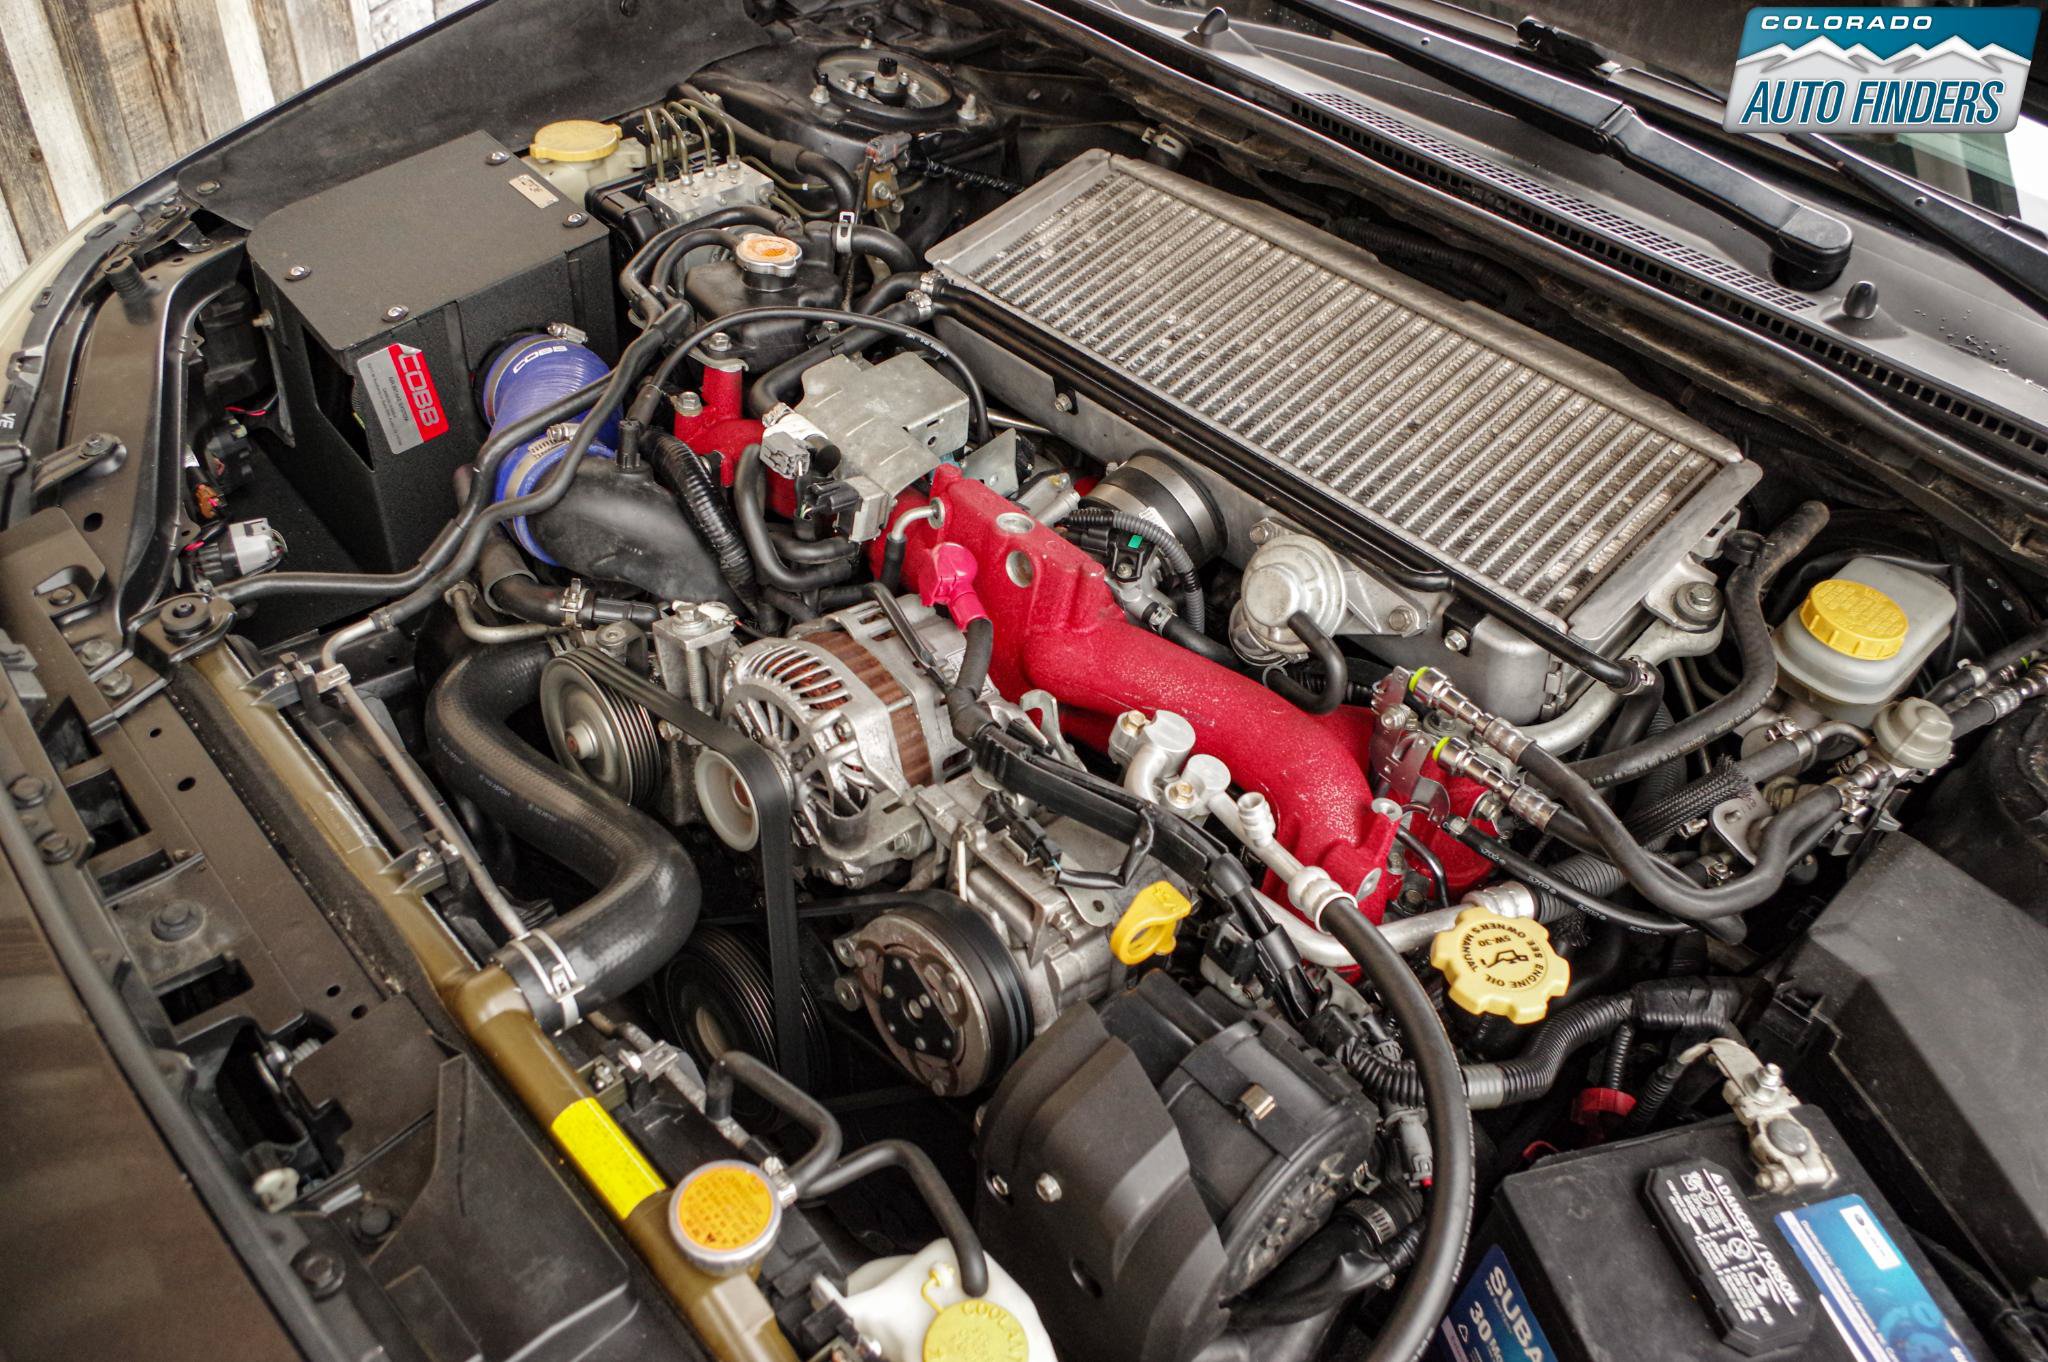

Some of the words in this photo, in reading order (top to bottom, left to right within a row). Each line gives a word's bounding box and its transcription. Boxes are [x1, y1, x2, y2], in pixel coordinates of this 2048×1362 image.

[512, 345, 568, 374] COBB
[398, 354, 440, 427] COBB
[1461, 933, 1478, 972] MANUAL
[1478, 935, 1511, 947] 5W-30
[1527, 939, 1543, 959] SEE
[1485, 973, 1506, 987] OIL
[1511, 963, 1544, 989] ENGINE
[1718, 1185, 1760, 1240] DANGER
[1759, 1251, 1801, 1303] POISON
[1470, 1301, 1491, 1342] 30
